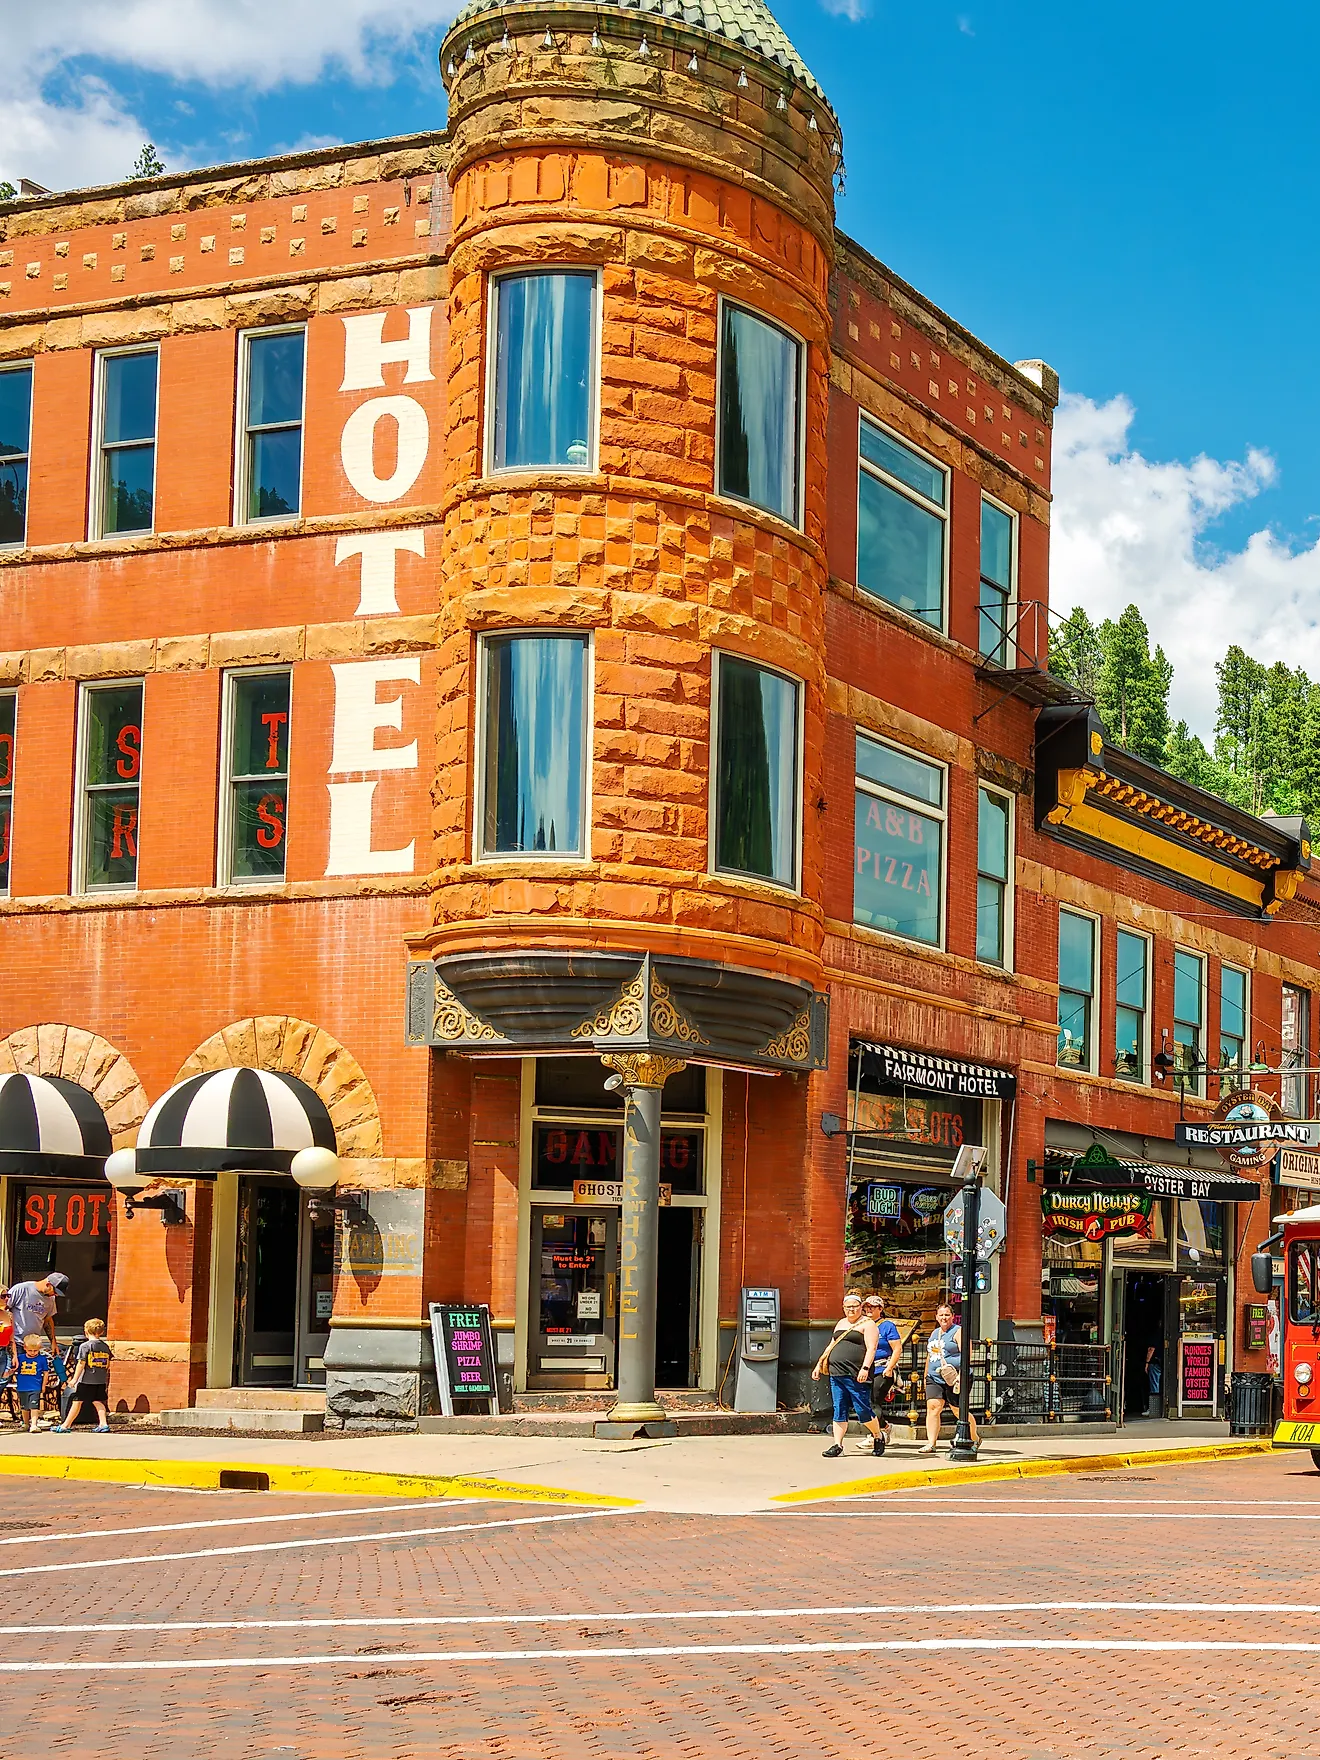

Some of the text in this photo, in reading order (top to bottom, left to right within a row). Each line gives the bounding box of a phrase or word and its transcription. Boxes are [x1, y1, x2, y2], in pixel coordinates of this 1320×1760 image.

[323, 306, 437, 878] HOTEL
[865, 800, 923, 845] A&B
[857, 846, 932, 897] PIZZA
[884, 1059, 999, 1096] FAIRMONT HOTEL
[1221, 1092, 1255, 1113] OYSTER
[907, 1108, 964, 1148] SLOTS
[1184, 1123, 1311, 1145] RESTAURANT
[1229, 1153, 1266, 1166] GAMING
[578, 1182, 622, 1196] GHOST
[1144, 1175, 1211, 1197] OYSTER BAY
[874, 1188, 896, 1202] BUD
[869, 1200, 900, 1215] LIGHT
[1052, 1214, 1136, 1230] IRISH PUB
[448, 1313, 480, 1328] FREE
[452, 1330, 480, 1340] JUMBO
[451, 1341, 483, 1351] SHRIMP
[1184, 1346, 1212, 1355] RONNIES
[456, 1356, 482, 1367] PIZZA
[1186, 1356, 1210, 1366] WORLD
[460, 1372, 482, 1382] BEER
[1184, 1368, 1211, 1377] FAMOUS
[1186, 1378, 1210, 1388] OYSTER
[1187, 1389, 1208, 1399] SHOTS
[1290, 1424, 1315, 1441] KOA
